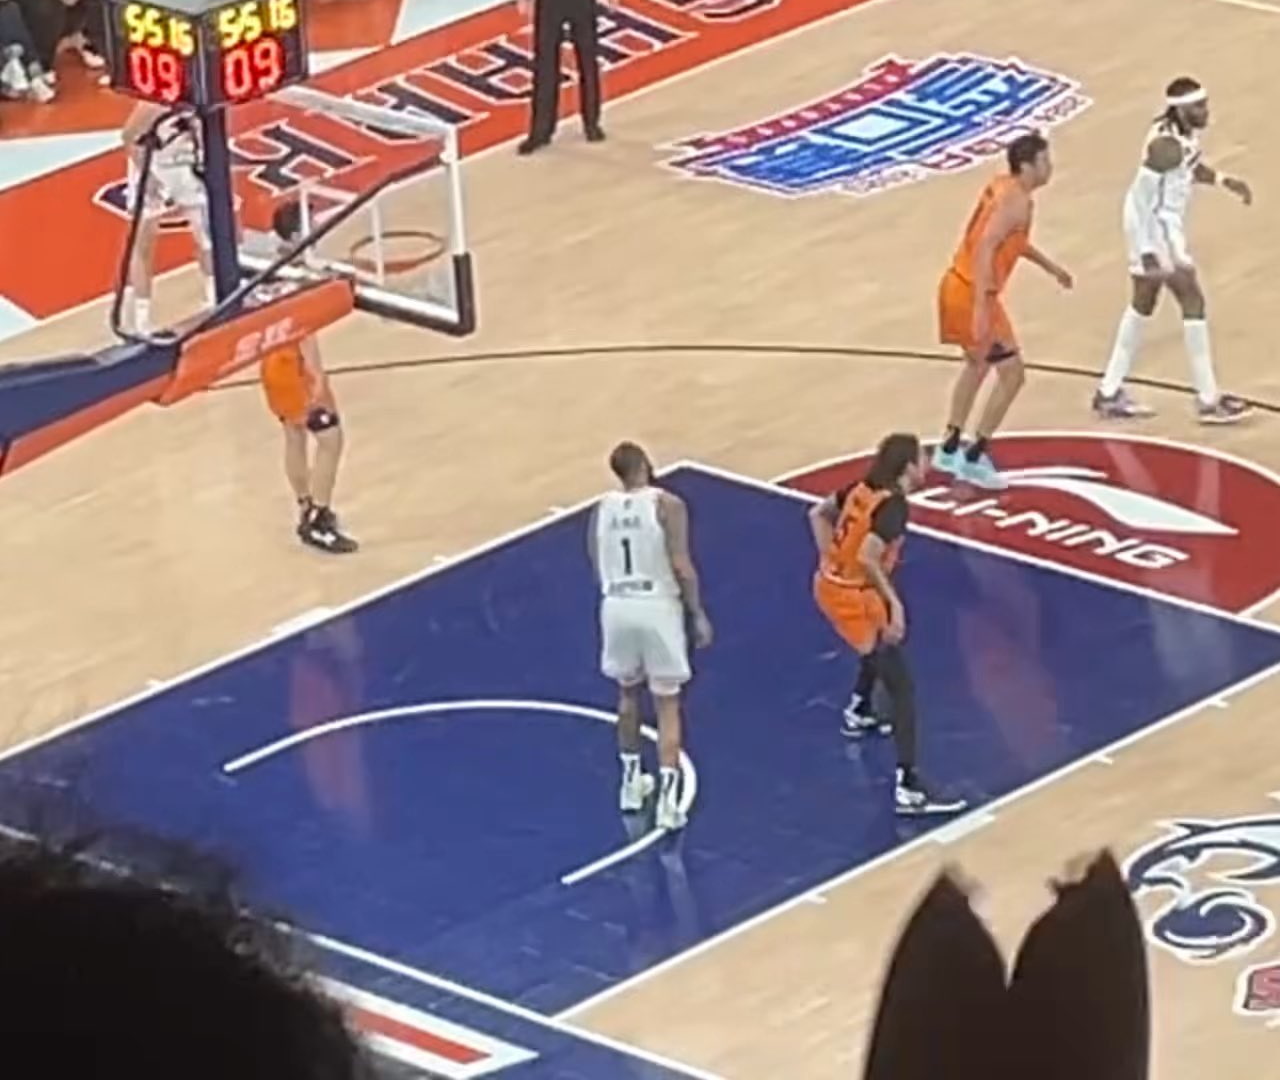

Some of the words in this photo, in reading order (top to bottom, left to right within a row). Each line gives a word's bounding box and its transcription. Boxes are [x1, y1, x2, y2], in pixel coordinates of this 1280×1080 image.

[130, 46, 181, 102] 09
[224, 37, 283, 97] 09
[621, 537, 633, 576] 1
[906, 486, 1191, 570] LI-NING
